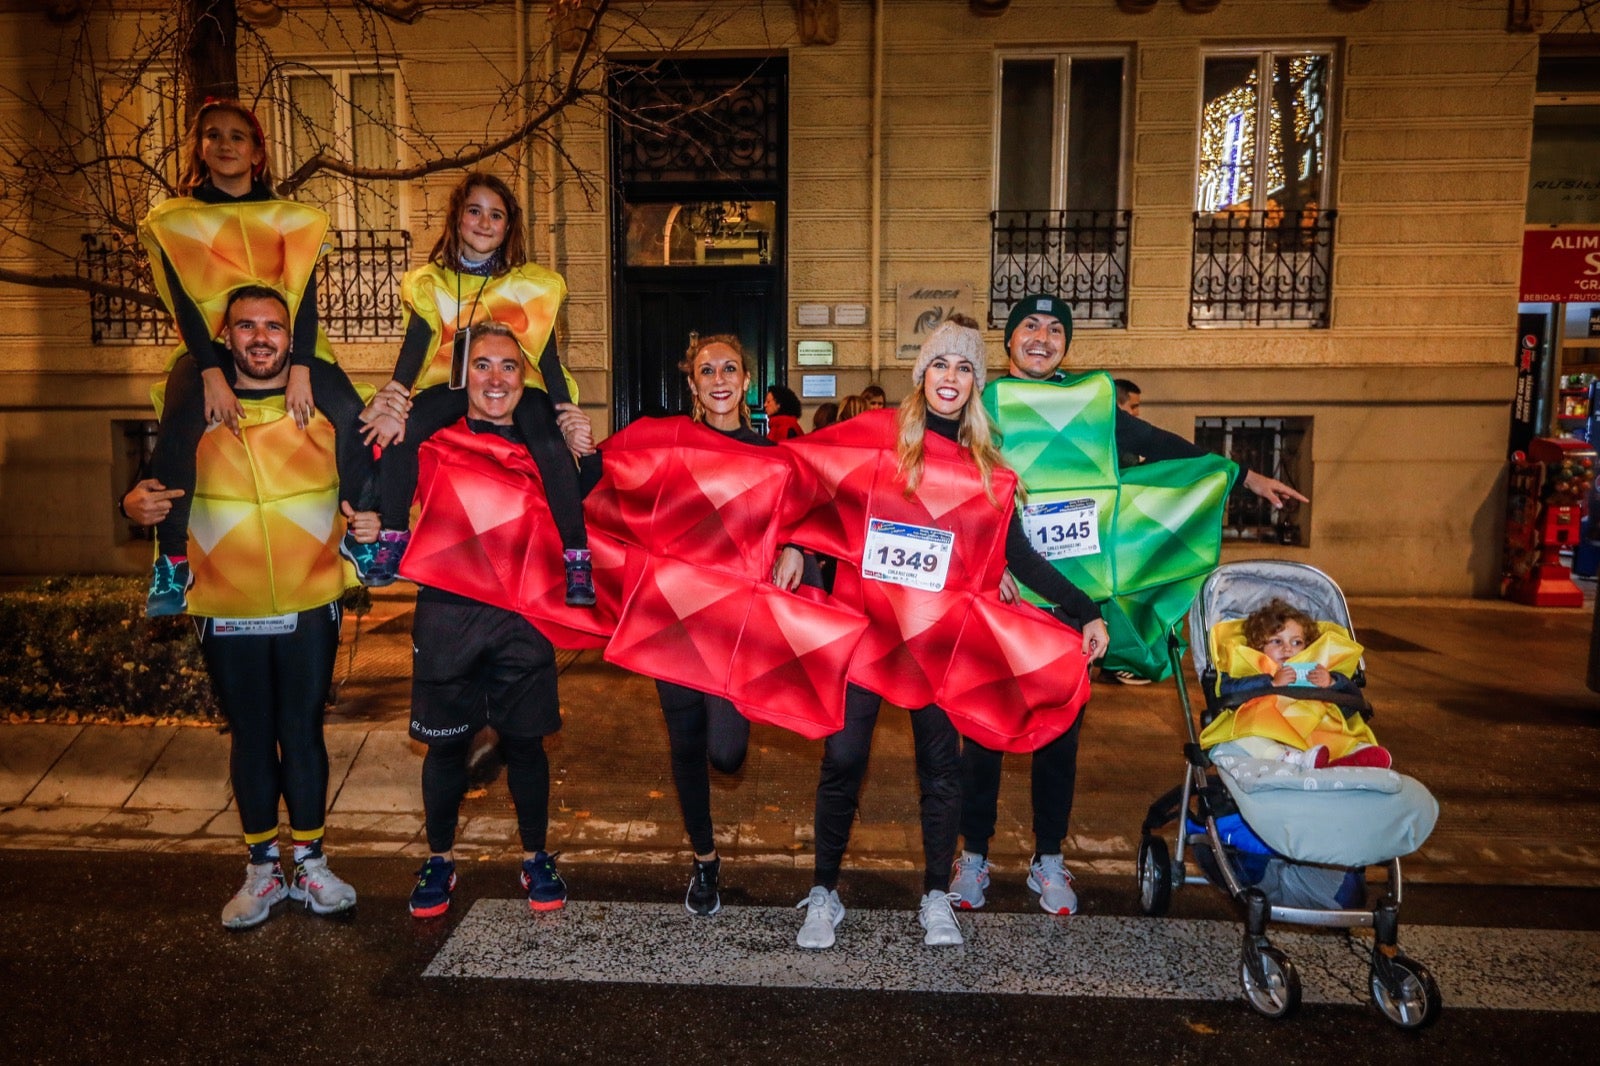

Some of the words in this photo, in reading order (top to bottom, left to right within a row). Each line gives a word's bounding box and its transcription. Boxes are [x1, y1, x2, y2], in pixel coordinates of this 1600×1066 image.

[1550, 236, 1599, 249] ALIM
[1523, 293, 1561, 302] BEBIDAS
[1036, 520, 1091, 544] 1345
[877, 546, 938, 573] 1349
[411, 720, 421, 731] EL
[421, 724, 469, 737] PADRINO
